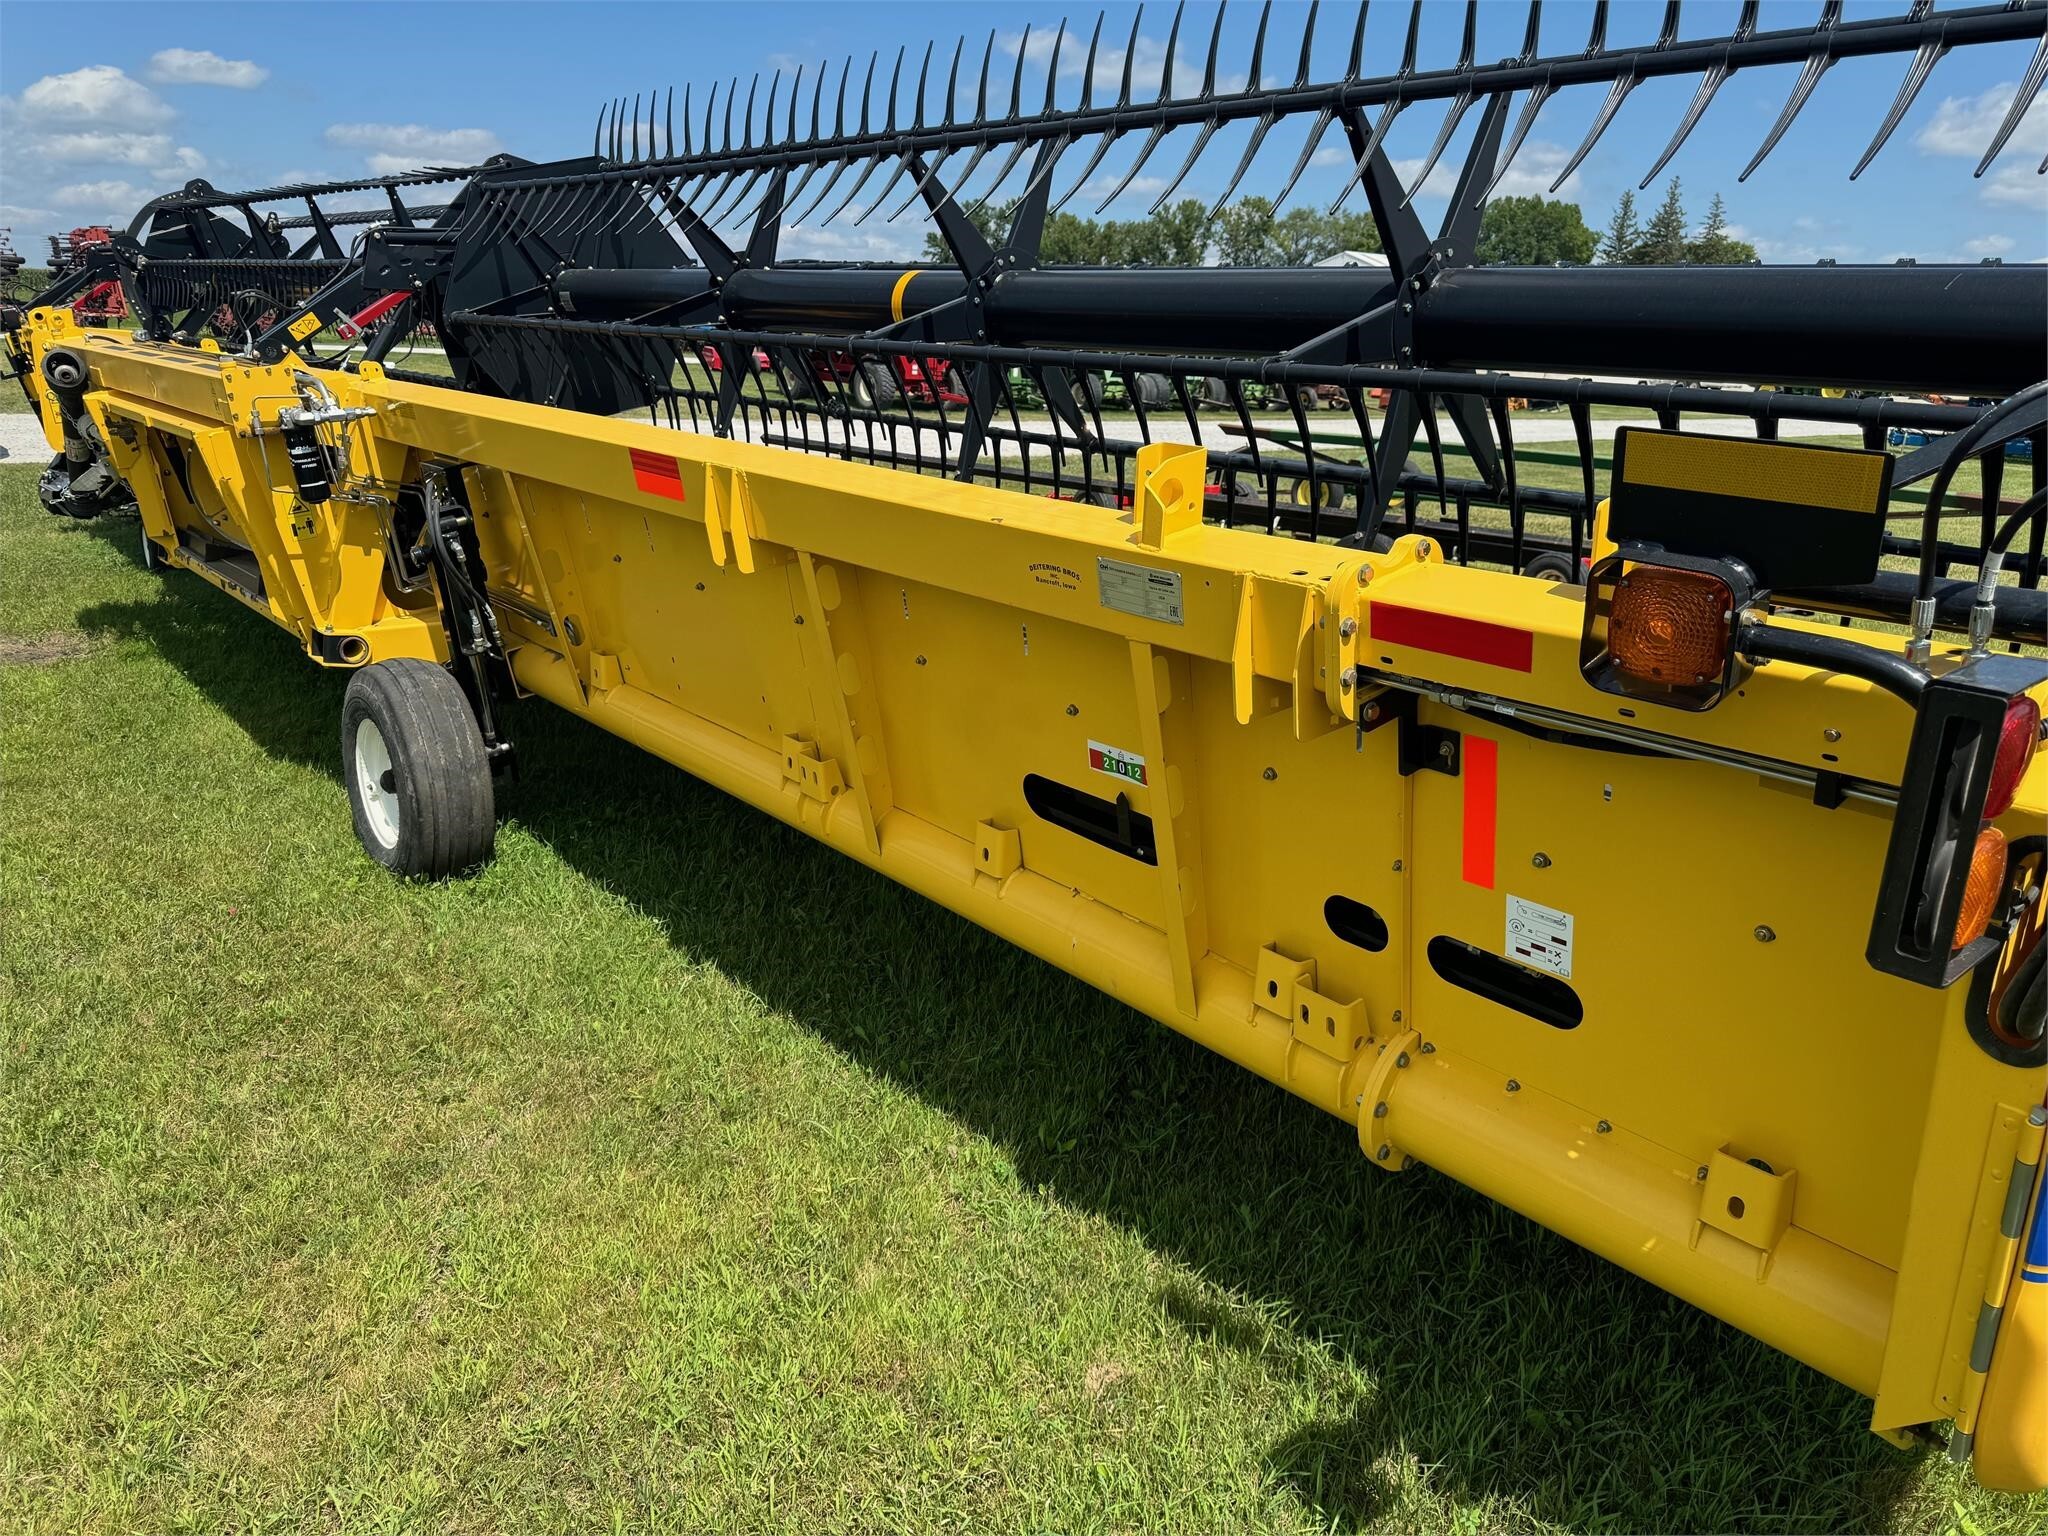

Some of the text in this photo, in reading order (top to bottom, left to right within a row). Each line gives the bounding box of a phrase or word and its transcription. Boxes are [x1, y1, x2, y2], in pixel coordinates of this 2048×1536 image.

[1029, 563, 1082, 583] DEITERING BROS.
[1035, 575, 1077, 590] Bancroft, Iowa
